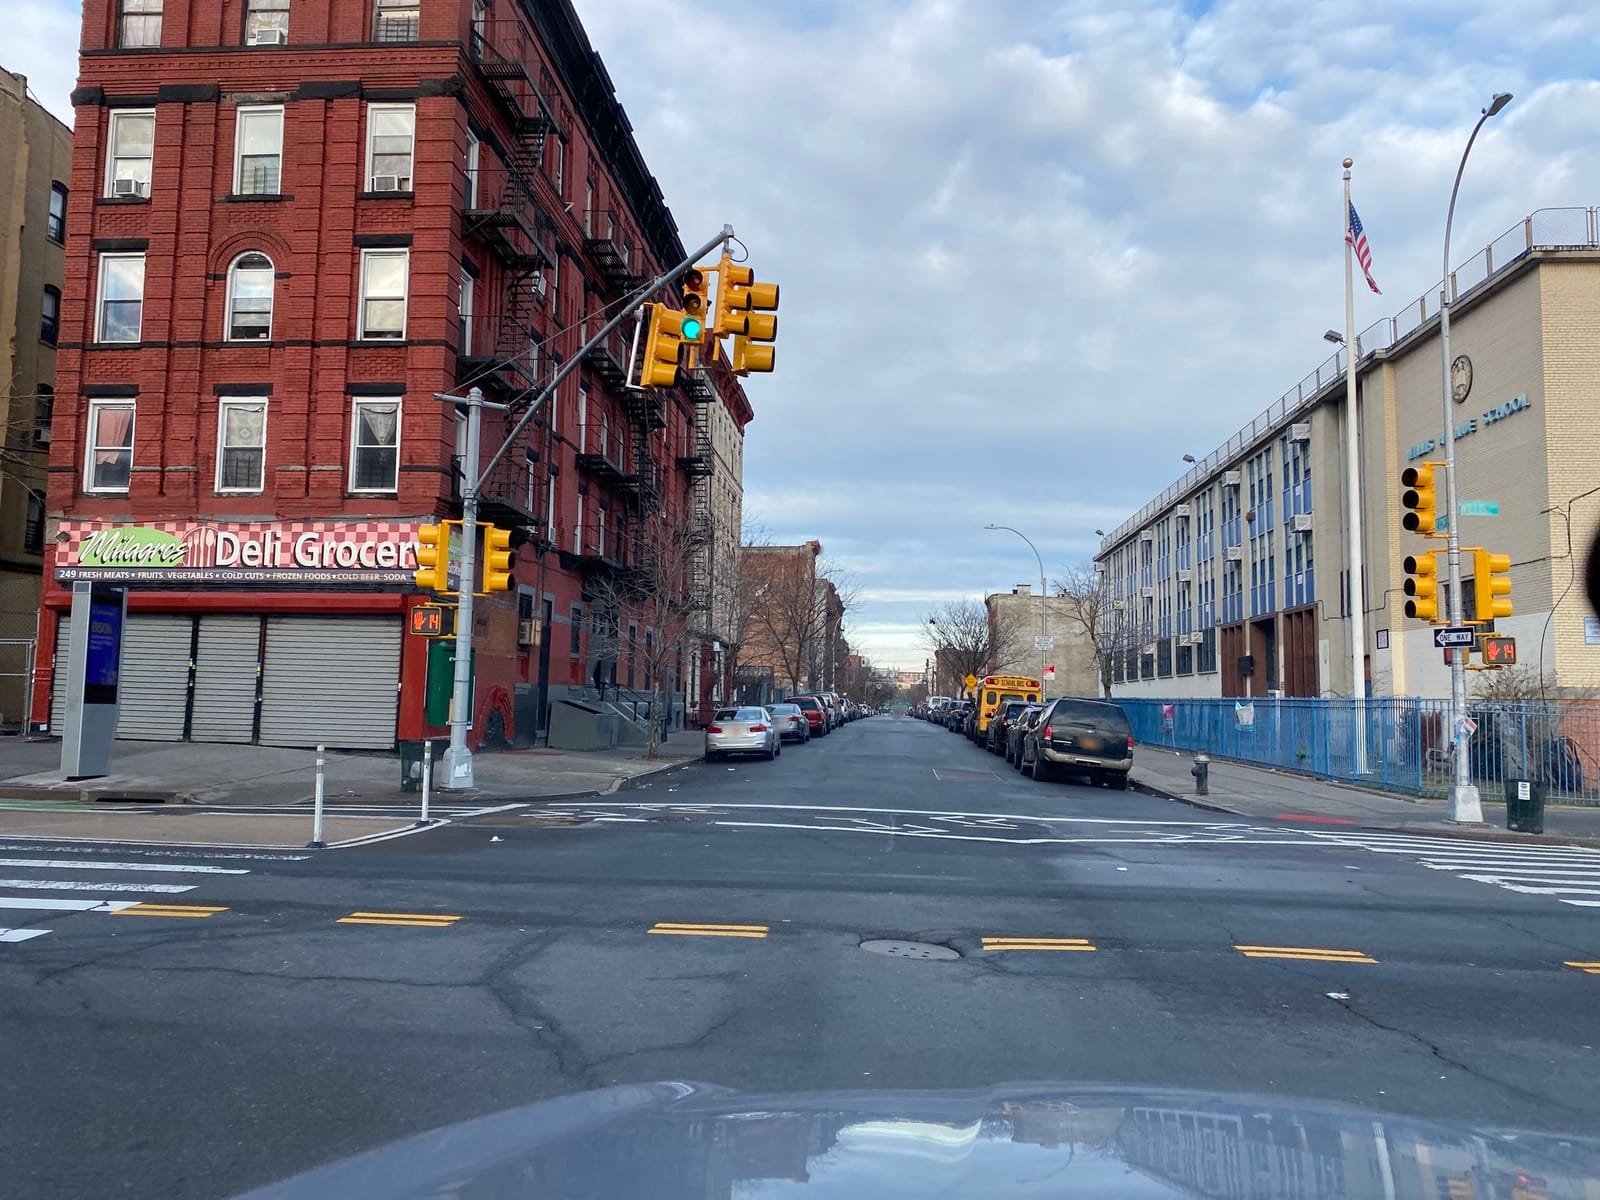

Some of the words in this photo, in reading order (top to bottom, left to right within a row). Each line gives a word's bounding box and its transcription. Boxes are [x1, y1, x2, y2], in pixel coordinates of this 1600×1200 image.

[1482, 393, 1532, 426] SCHOOL
[78, 530, 188, 566] Milagros
[215, 529, 282, 567] Deli
[59, 570, 77, 578] 249
[78, 571, 102, 579] FRESH
[103, 571, 130, 579] MEATS
[167, 571, 214, 580] VEGETABLES
[222, 572, 243, 580] COLD
[244, 572, 264, 580] CUTS
[272, 573, 302, 581] FROZEN
[304, 573, 331, 581] FOODS
[337, 573, 359, 581] COLD
[360, 573, 380, 581] BEER
[383, 573, 407, 581] SODA
[428, 613, 439, 630] 14
[1439, 632, 1452, 642] ONE
[1456, 631, 1469, 641] WAY
[1503, 644, 1514, 660] 14
